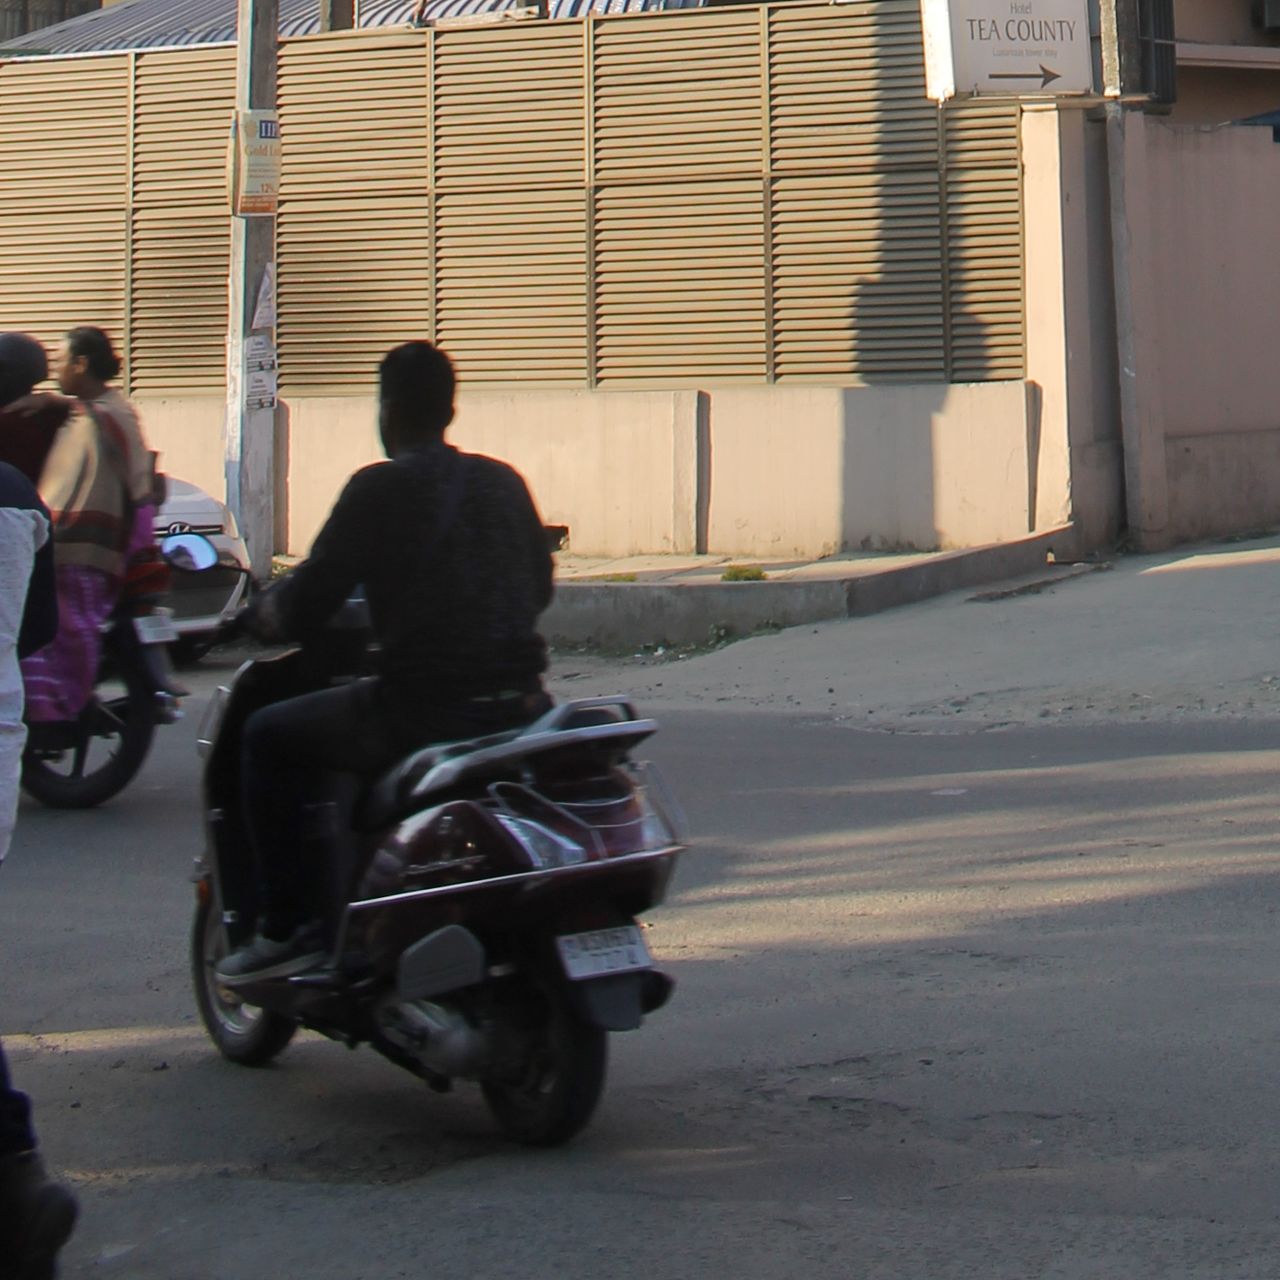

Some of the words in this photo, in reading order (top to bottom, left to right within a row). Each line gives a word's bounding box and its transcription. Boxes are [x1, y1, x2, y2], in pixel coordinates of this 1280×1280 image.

[1010, 1, 1033, 15] Hotel
[966, 18, 1002, 41] TEA
[1005, 18, 1077, 42] COUNTY
